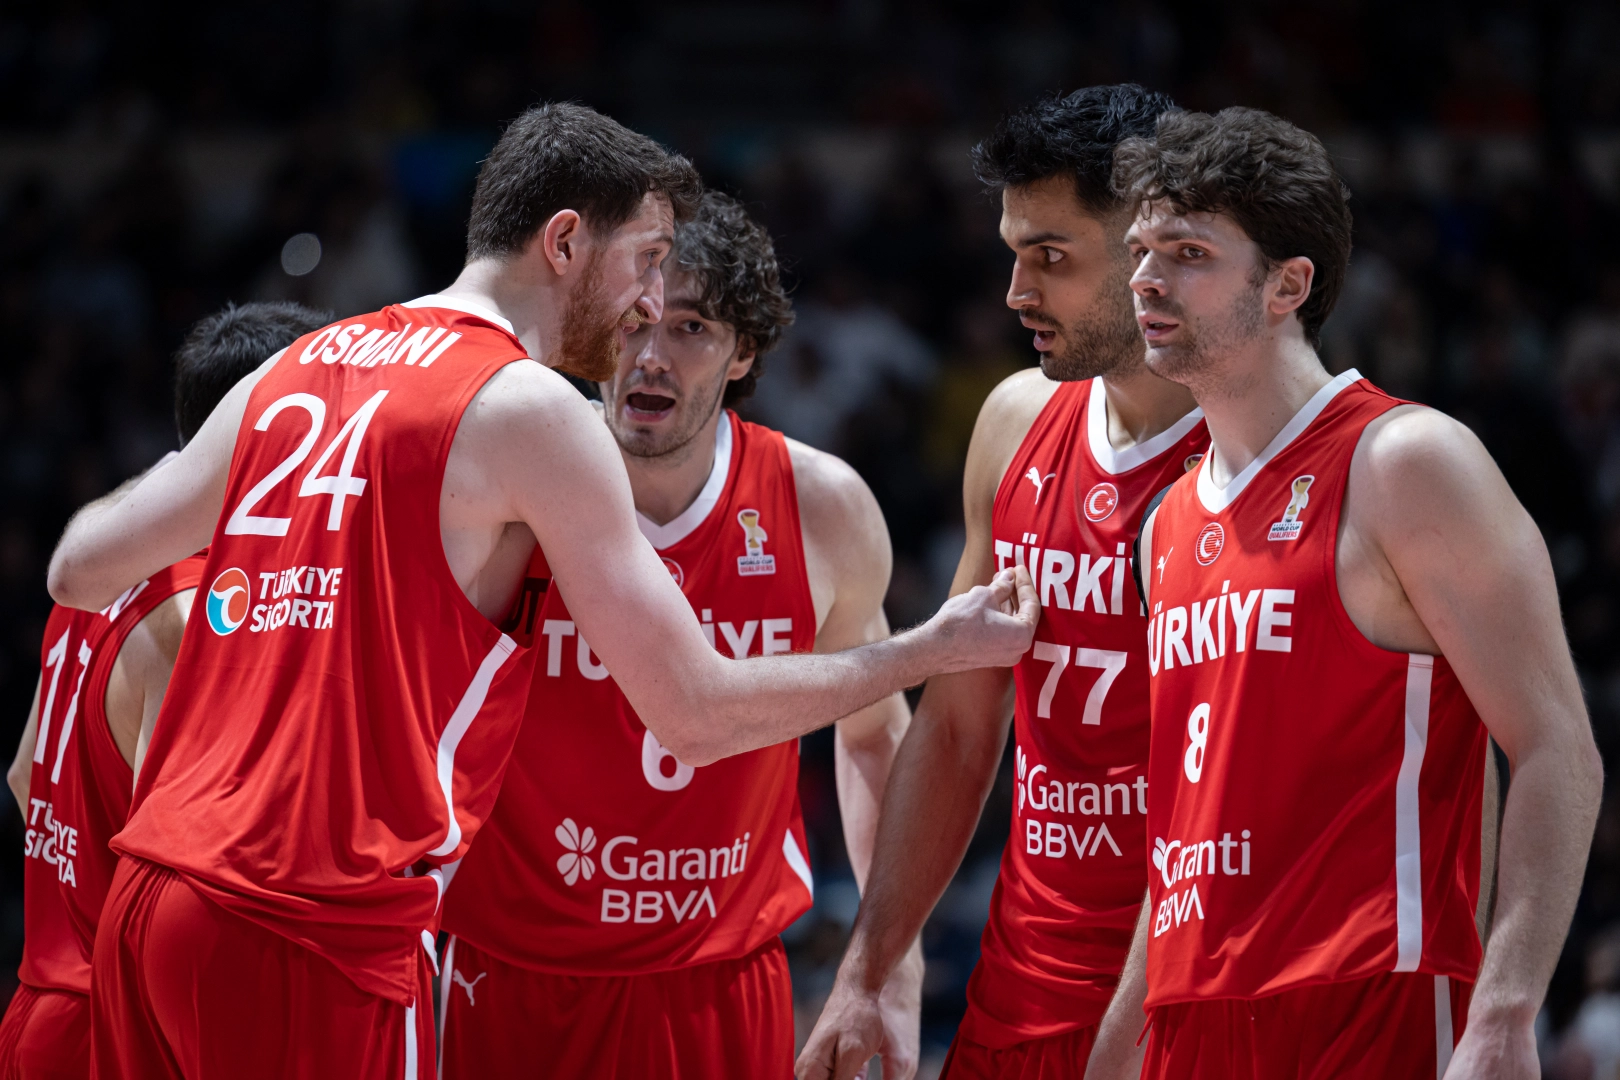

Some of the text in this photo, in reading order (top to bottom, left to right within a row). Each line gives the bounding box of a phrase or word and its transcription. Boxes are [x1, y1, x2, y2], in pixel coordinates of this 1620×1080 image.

[299, 323, 463, 368] OSMANI
[224, 389, 390, 537] 24
[995, 532, 1147, 617] TÜRKİ
[1147, 579, 1296, 678] ÜRKİYE
[33, 624, 92, 785] 11
[1032, 640, 1128, 726] 77
[641, 728, 695, 792] 6
[1184, 702, 1211, 784] 8
[1027, 764, 1149, 816] Garant
[601, 831, 751, 881] Garanti
[1026, 818, 1123, 861] BBVA
[1161, 829, 1251, 890] Granti
[600, 885, 717, 924] BBVA
[1154, 883, 1205, 938] BBVA
